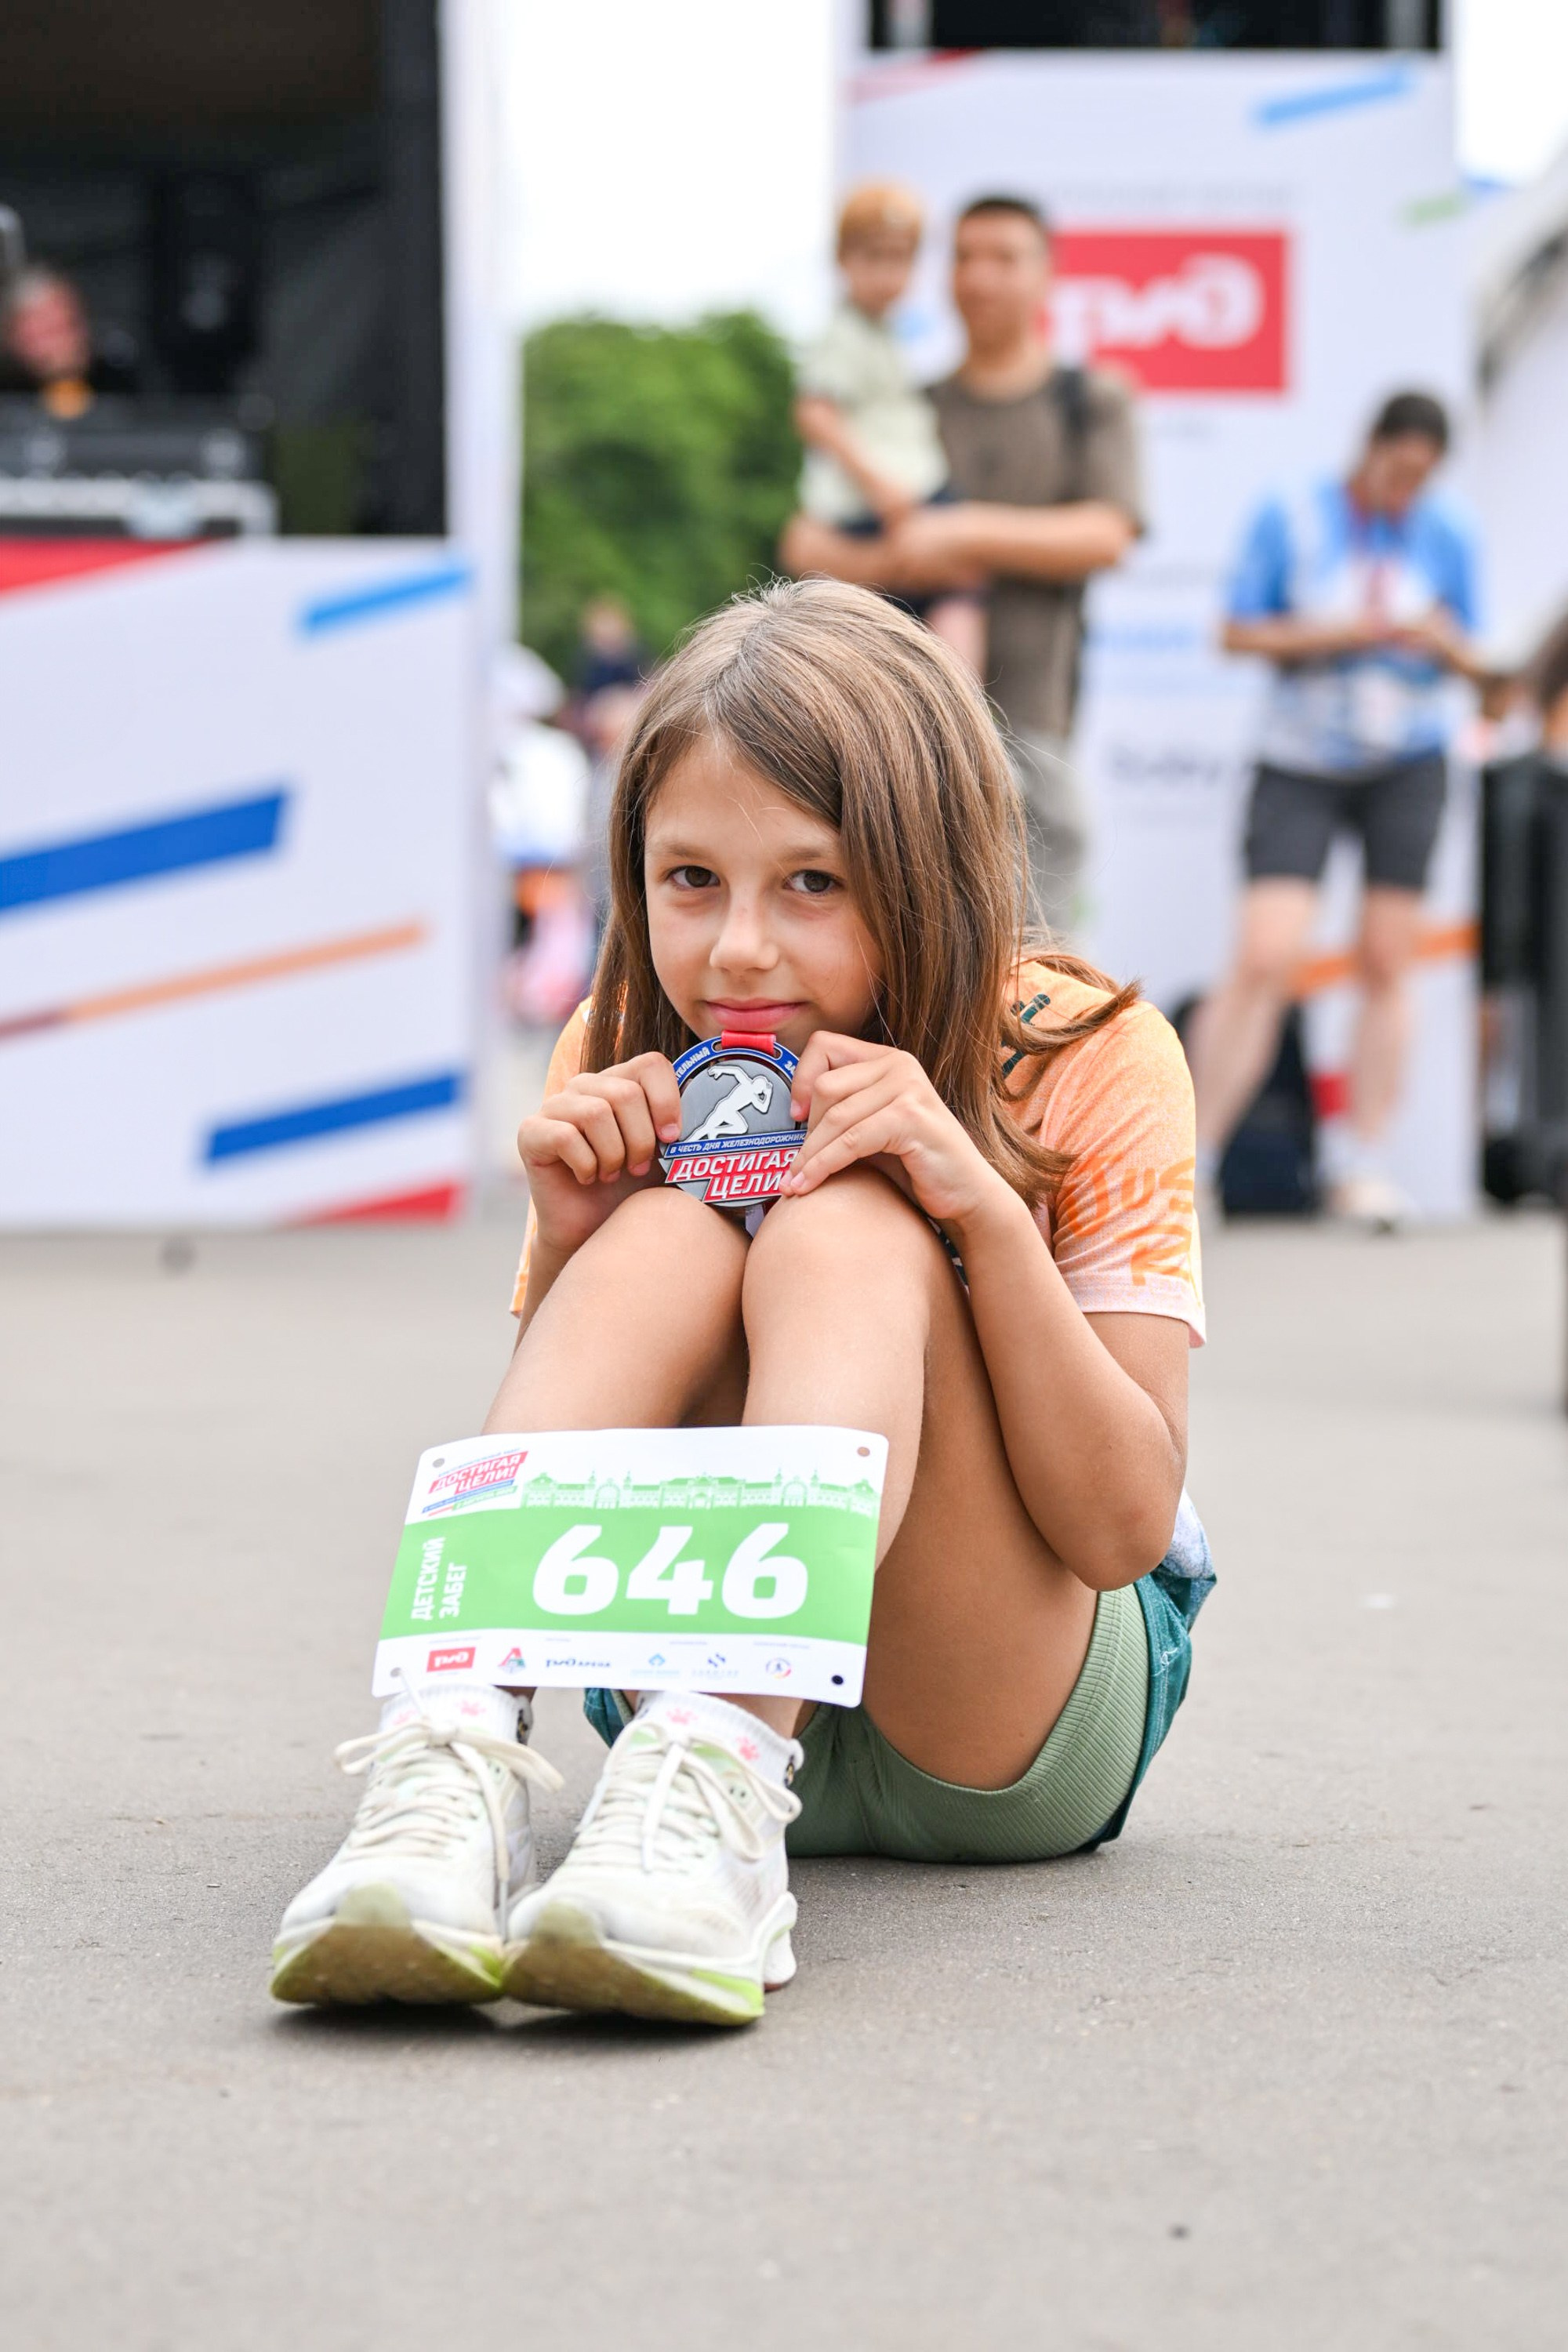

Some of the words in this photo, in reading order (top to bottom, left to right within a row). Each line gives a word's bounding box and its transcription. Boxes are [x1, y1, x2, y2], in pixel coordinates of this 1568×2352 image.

[675, 1046, 710, 1080] ТЕЛЬНЫЙ
[670, 1145, 676, 1154] В
[678, 1144, 702, 1152] ЧЕСТЬ
[702, 1142, 720, 1152] ДНЯ
[720, 1133, 805, 1149] ЖЕЛЕЗНОДОРОЖНИК
[673, 1149, 800, 1181] ДОСТИГАЯ
[435, 1454, 522, 1492] ДОСТИГАЯ
[459, 1465, 516, 1492] ЦЕЛИ!
[410, 1536, 446, 1621] ДЕТСКИЙ
[532, 1523, 809, 1619] 646
[439, 1562, 468, 1619] ЗАБЕГ
